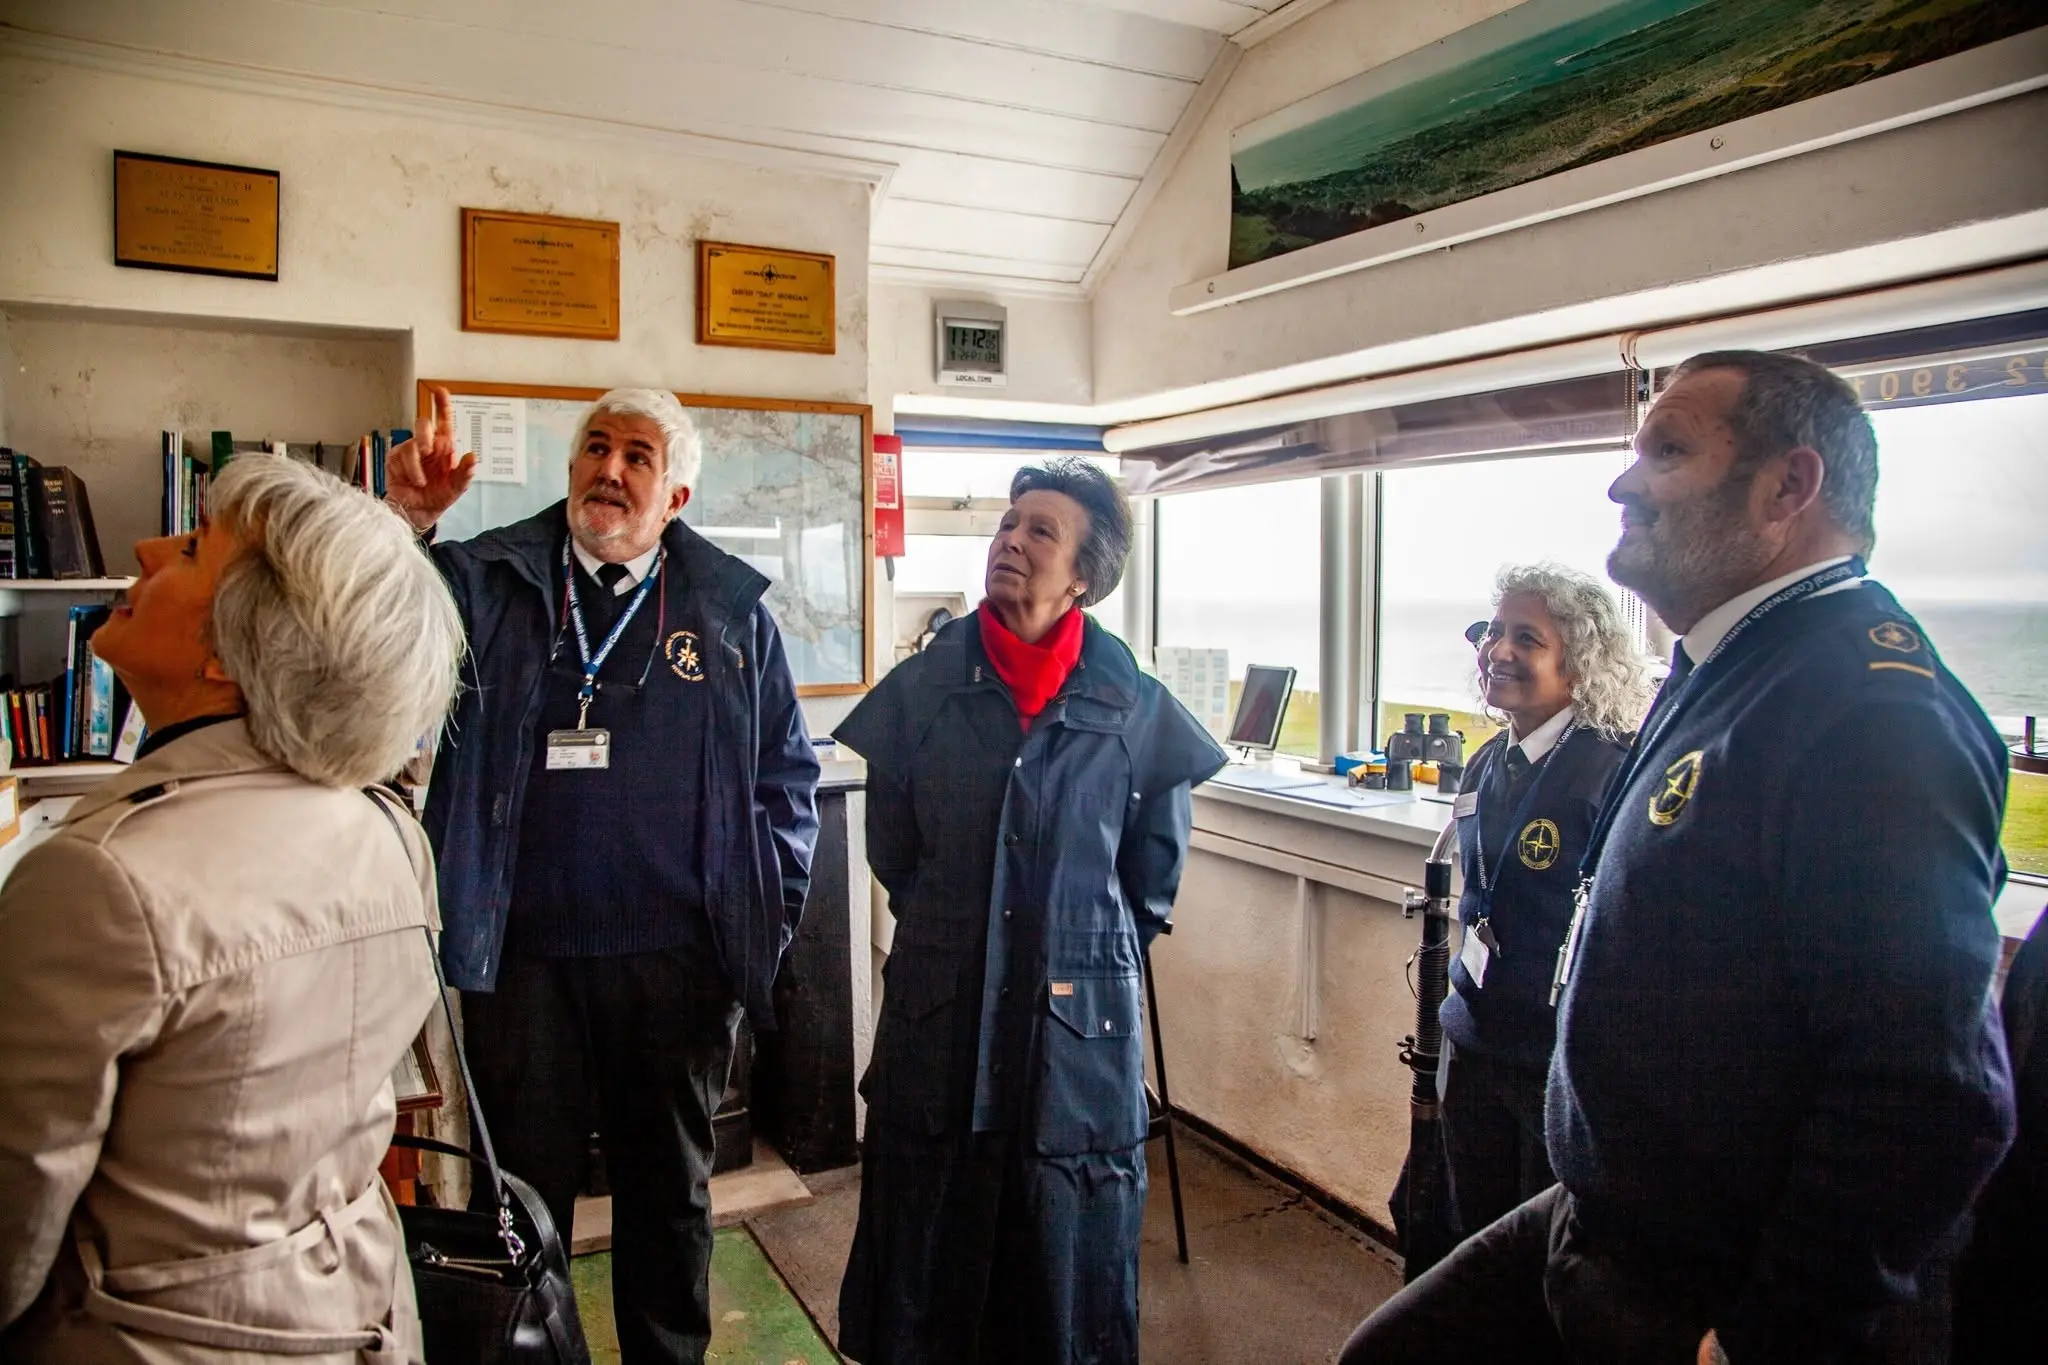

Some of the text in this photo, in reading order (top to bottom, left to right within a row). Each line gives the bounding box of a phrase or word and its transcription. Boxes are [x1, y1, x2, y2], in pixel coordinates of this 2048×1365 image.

[776, 292, 810, 302] MORGAN
[954, 374, 993, 384] LOCAL TIME
[1751, 579, 1816, 620] Coastwatch
[1704, 617, 1753, 664] Institution
